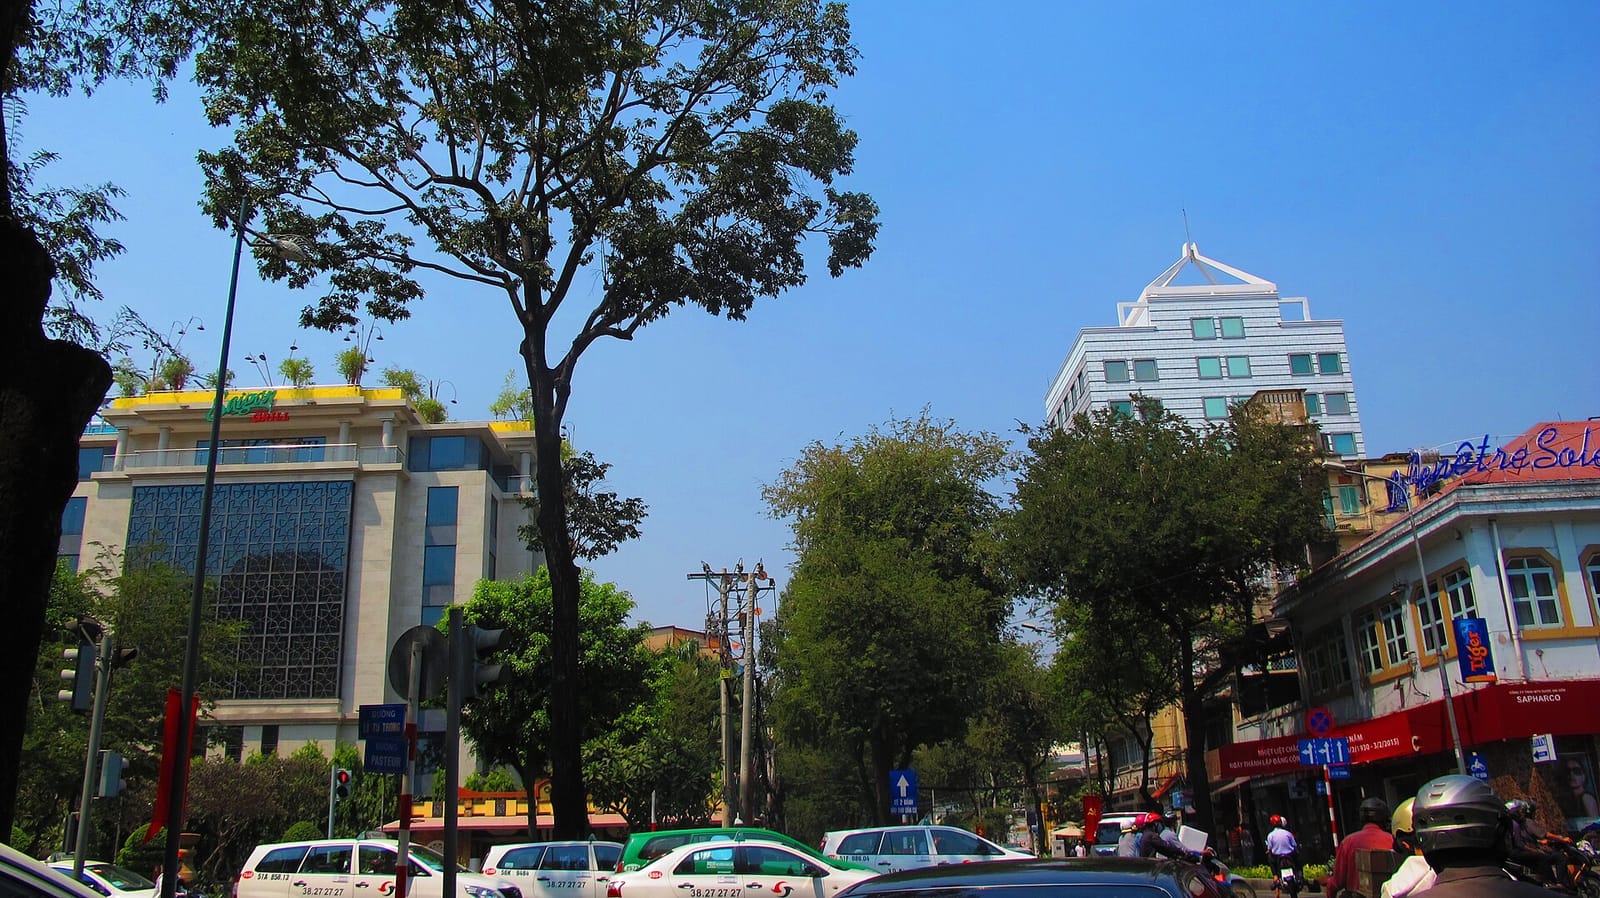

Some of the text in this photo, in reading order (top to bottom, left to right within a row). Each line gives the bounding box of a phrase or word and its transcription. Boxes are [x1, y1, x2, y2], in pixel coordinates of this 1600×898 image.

[1466, 631, 1488, 672] Tiger
[1516, 694, 1561, 704] SAPHARCO
[1349, 733, 1364, 743] NĂM
[1347, 742, 1370, 754] /2/1930
[371, 755, 401, 768] PASTEUR
